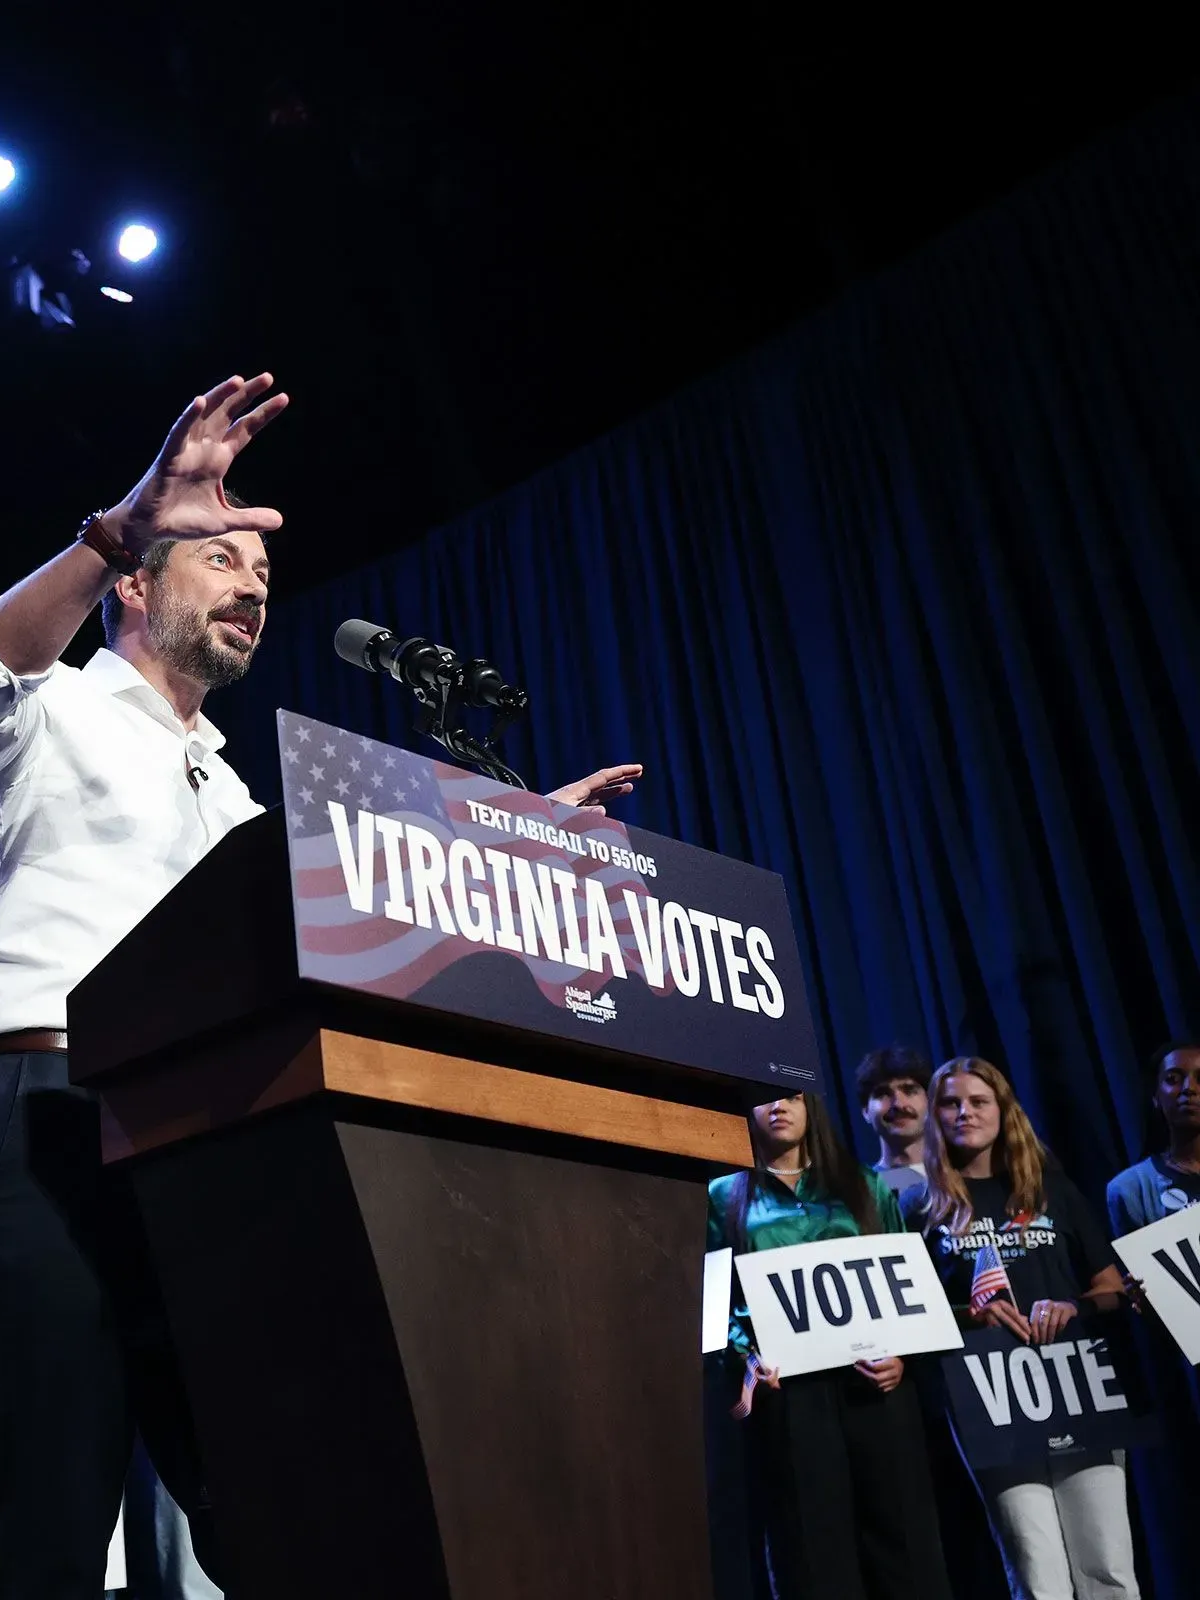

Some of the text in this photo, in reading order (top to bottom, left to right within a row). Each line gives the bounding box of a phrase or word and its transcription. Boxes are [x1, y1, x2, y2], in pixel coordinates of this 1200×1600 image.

[466, 799, 658, 878] TEXT ABIGAIL TO 55105
[327, 800, 786, 1020] VIRGINIA VOTES
[565, 985, 591, 1001] Abigail
[565, 996, 617, 1020] Spanberger
[767, 1254, 926, 1334] VOTE
[963, 1337, 1129, 1428] VOTE
